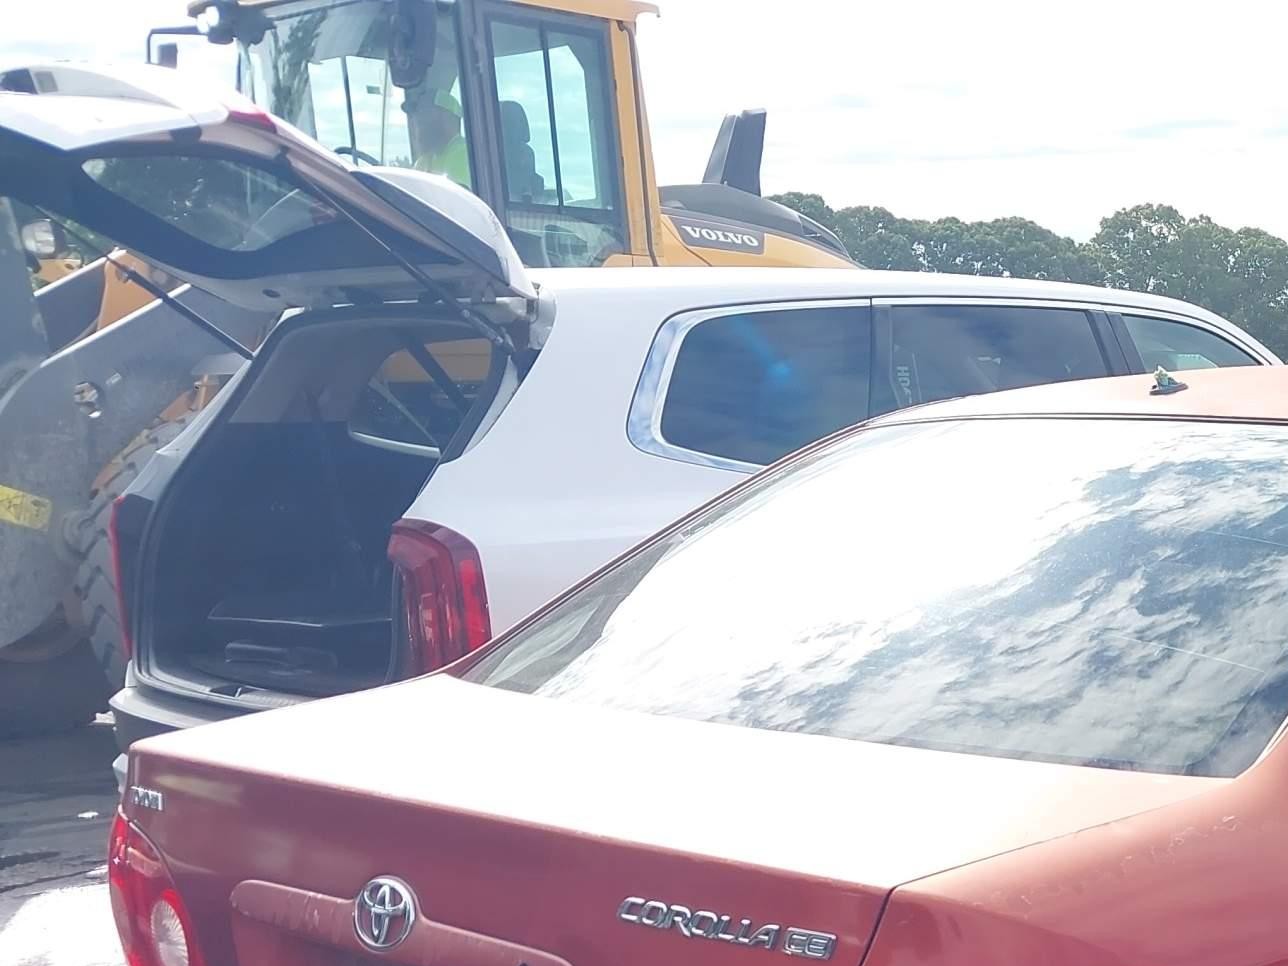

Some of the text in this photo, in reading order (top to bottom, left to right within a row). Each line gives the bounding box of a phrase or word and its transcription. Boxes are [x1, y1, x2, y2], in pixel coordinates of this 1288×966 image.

[681, 225, 759, 247] VOLVO
[617, 896, 838, 960] COROLLA CE
